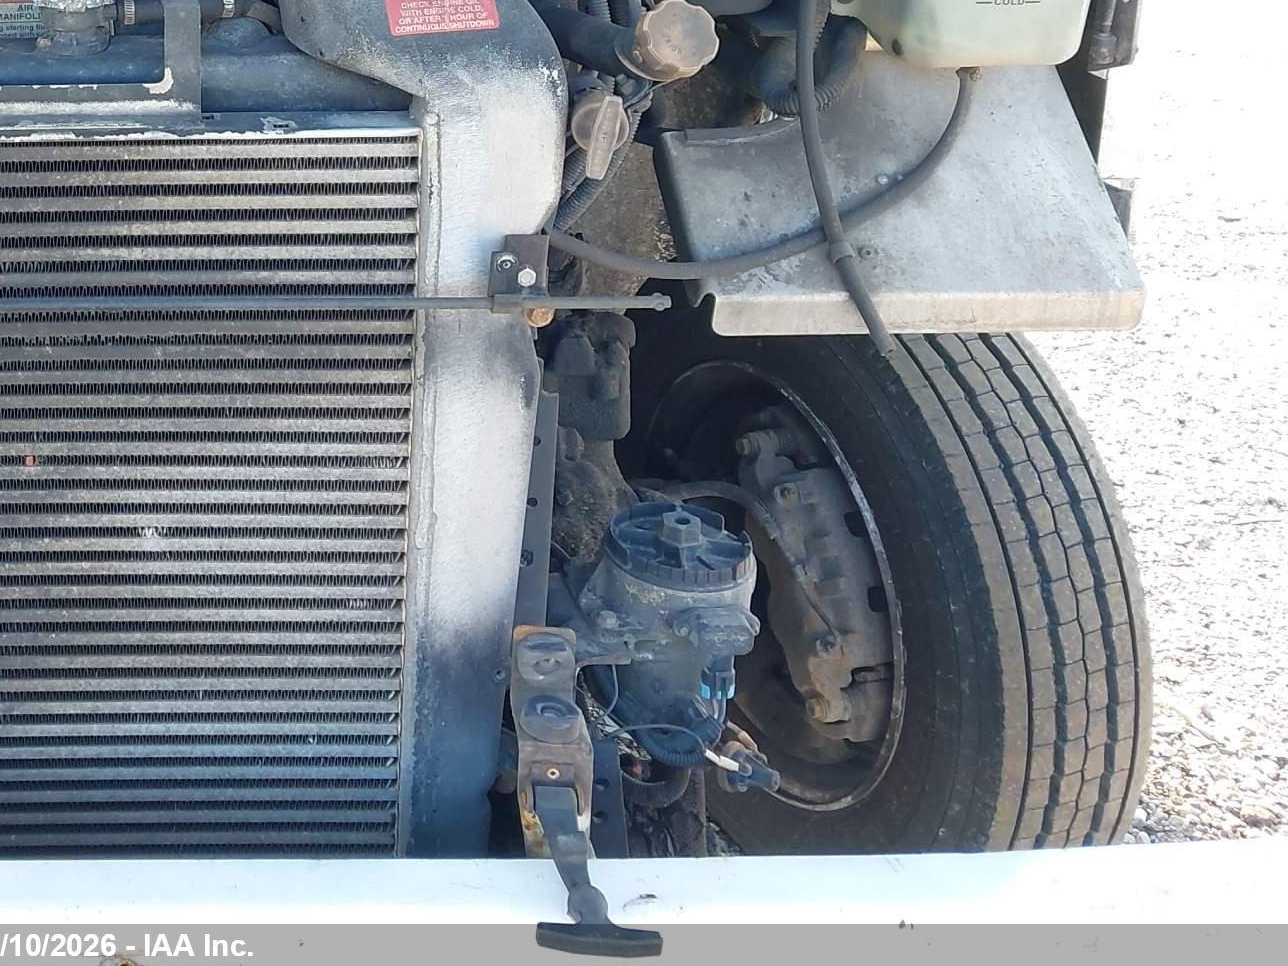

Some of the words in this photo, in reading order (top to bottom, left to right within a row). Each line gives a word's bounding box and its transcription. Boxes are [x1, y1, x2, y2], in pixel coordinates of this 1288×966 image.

[17, 4, 34, 12] AIR
[400, 8, 422, 17] WITH
[399, 17, 412, 25] OR
[413, 15, 441, 24] AFTER
[450, 13, 475, 22] HOUR
[6, 24, 34, 32] starting
[395, 22, 448, 34] CONTINUOUS
[449, 19, 494, 30] SHUTDOWN
